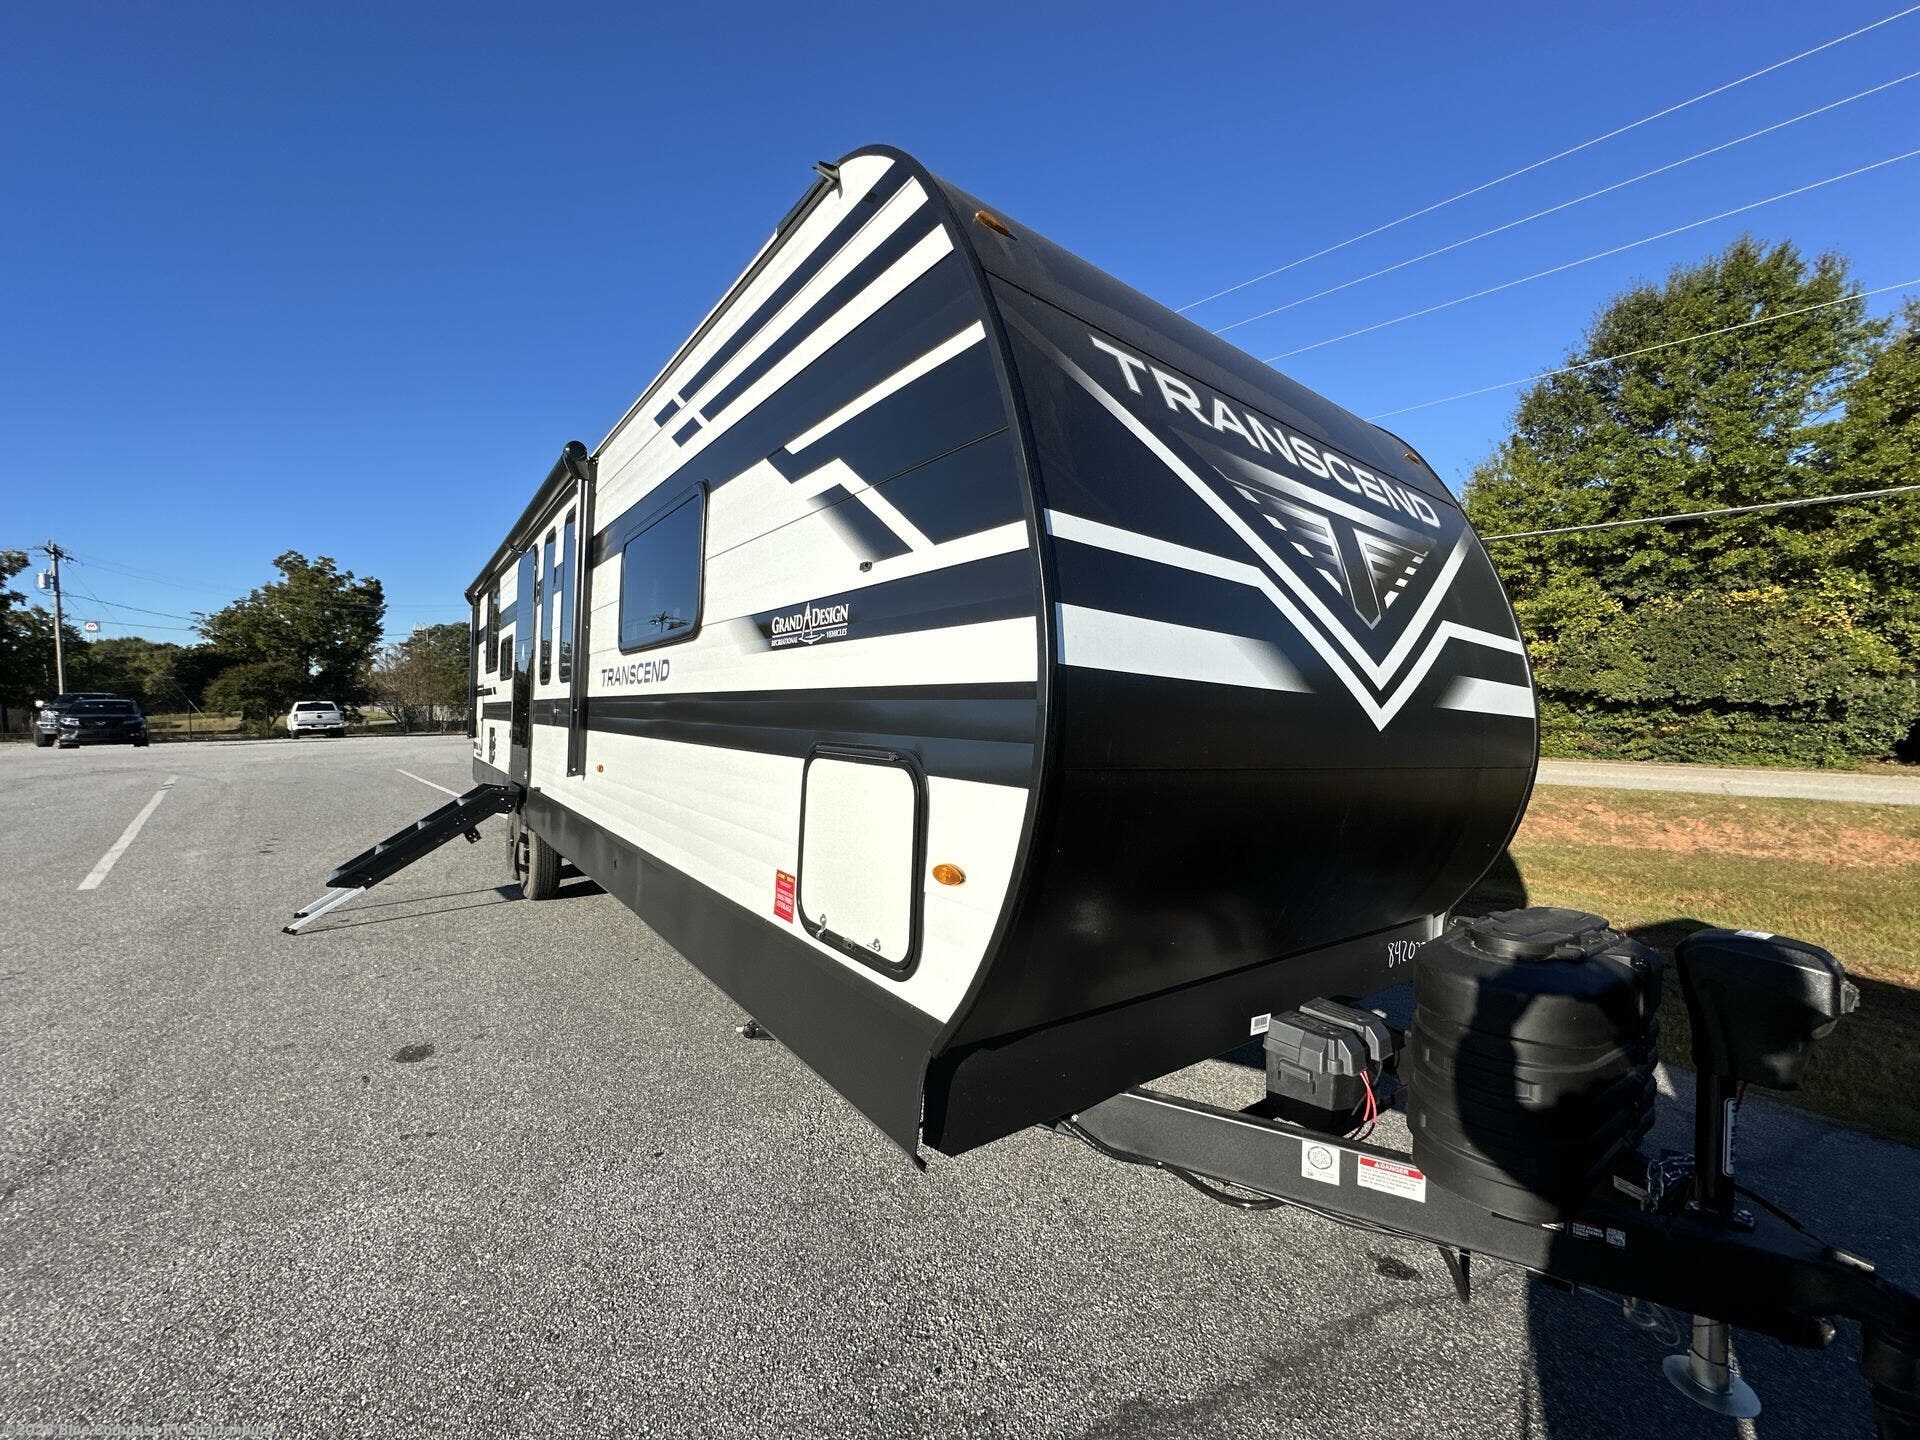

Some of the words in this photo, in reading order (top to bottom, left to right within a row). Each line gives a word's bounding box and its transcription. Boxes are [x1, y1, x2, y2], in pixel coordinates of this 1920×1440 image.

[1089, 334, 1441, 529] TRANSCEND
[771, 614, 803, 634] GRAND
[811, 603, 850, 627] DESIGN
[826, 627, 848, 639] VEHICLES
[601, 659, 670, 687] TRANSCEND
[1387, 940, 1427, 968] 8420
[1379, 1162, 1410, 1176] DANGER
